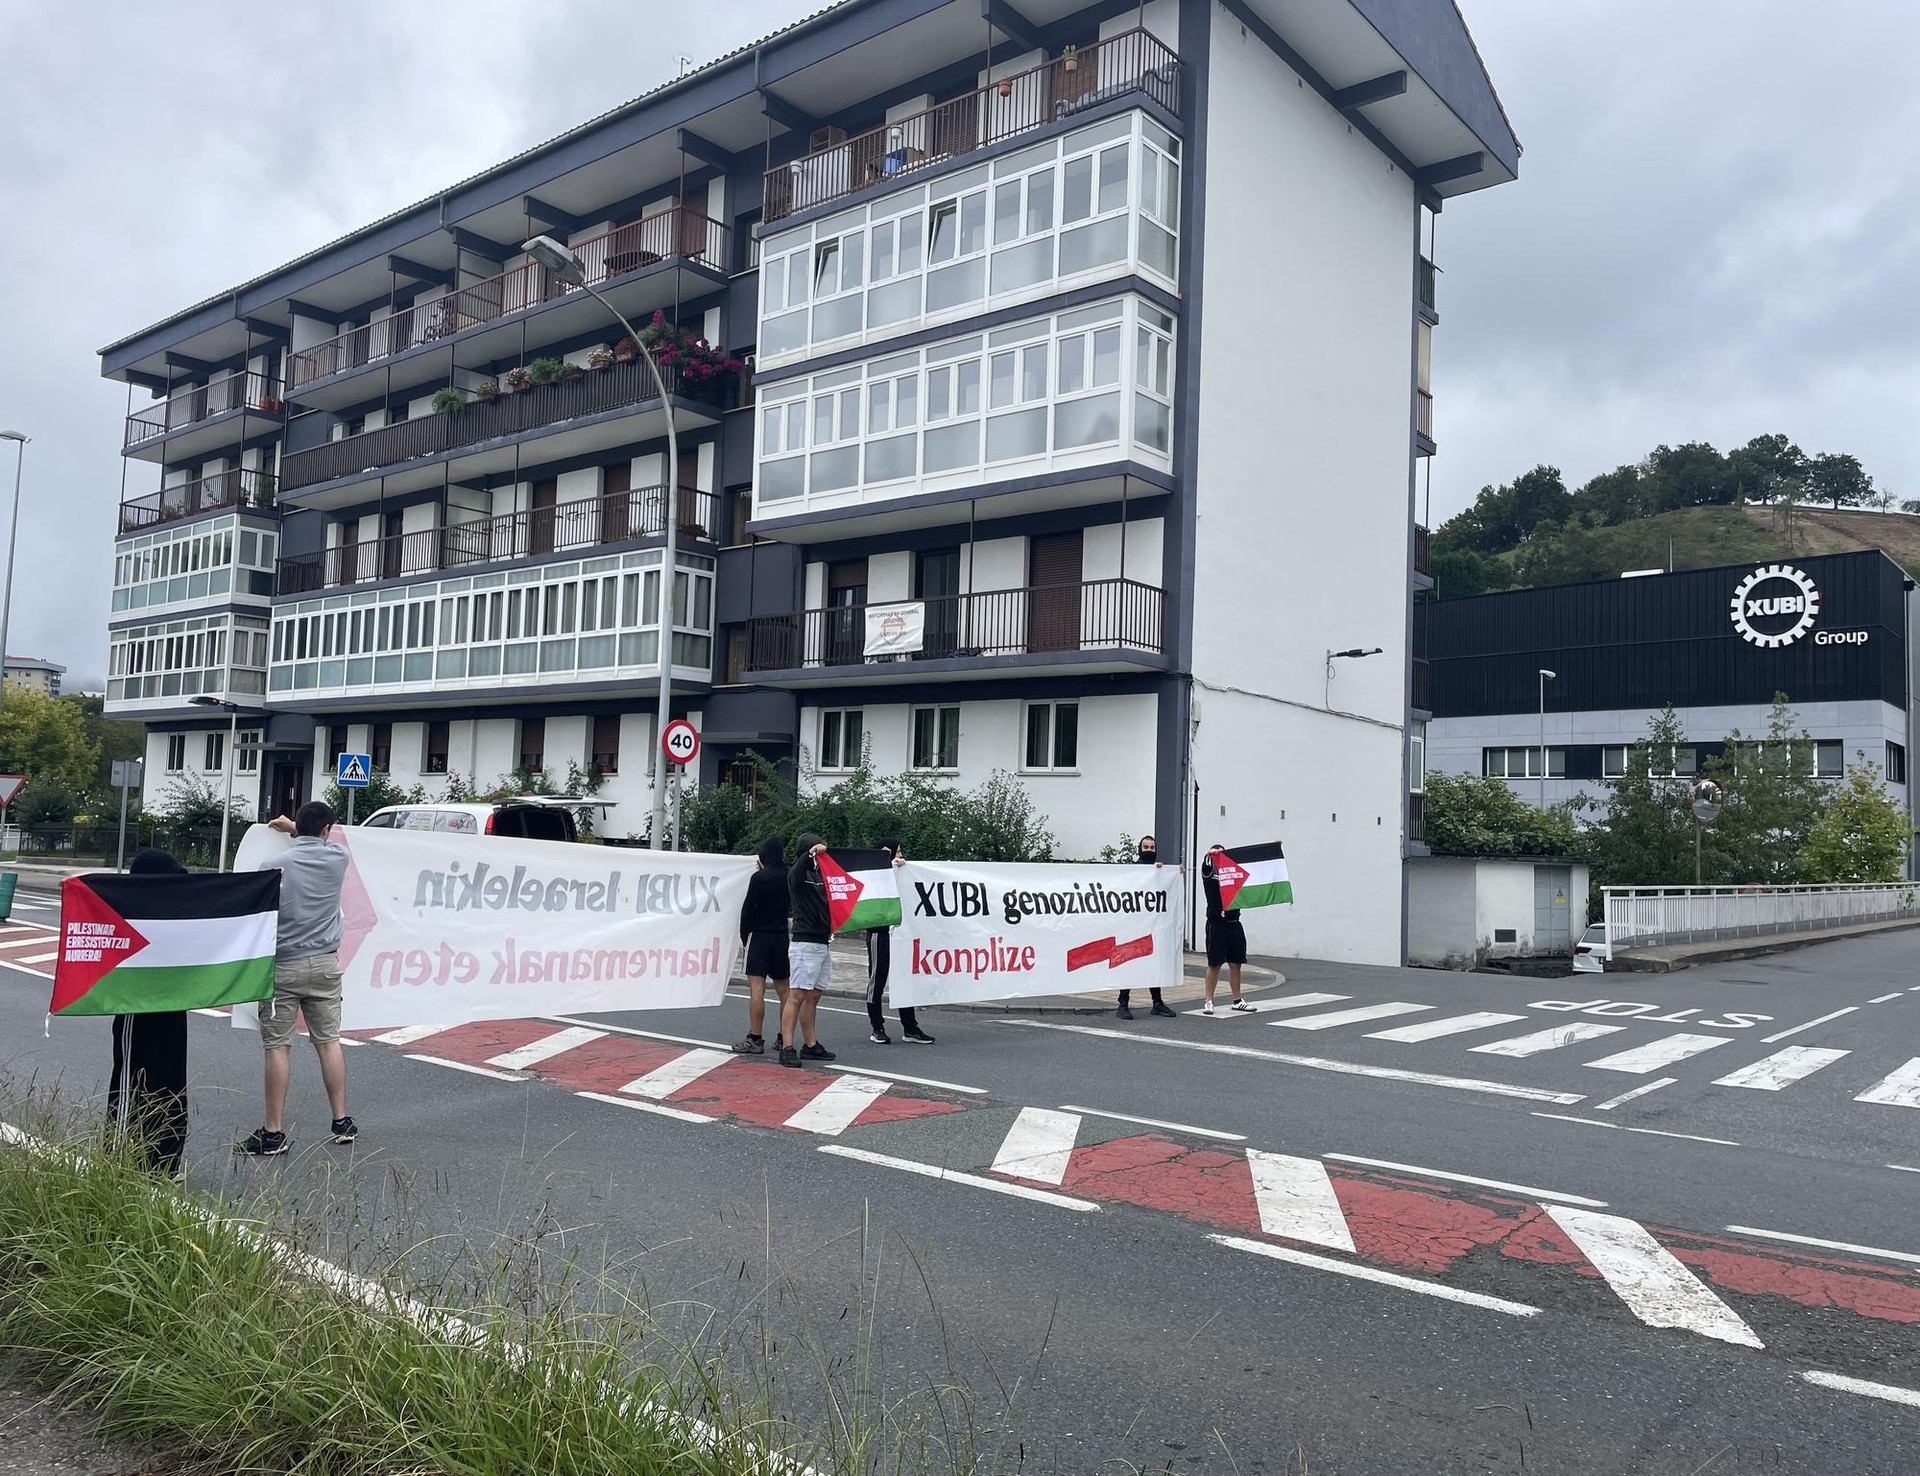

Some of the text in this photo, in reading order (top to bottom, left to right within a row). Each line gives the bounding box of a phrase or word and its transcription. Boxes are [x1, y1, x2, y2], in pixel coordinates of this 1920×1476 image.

[1746, 596, 1804, 617] XUBI
[1815, 631, 1868, 645] Group
[671, 733, 692, 749] 40
[914, 881, 1168, 925] XUBI genozidioaren
[911, 936, 1036, 980] konplize
[1526, 999, 1775, 1028] STOP
